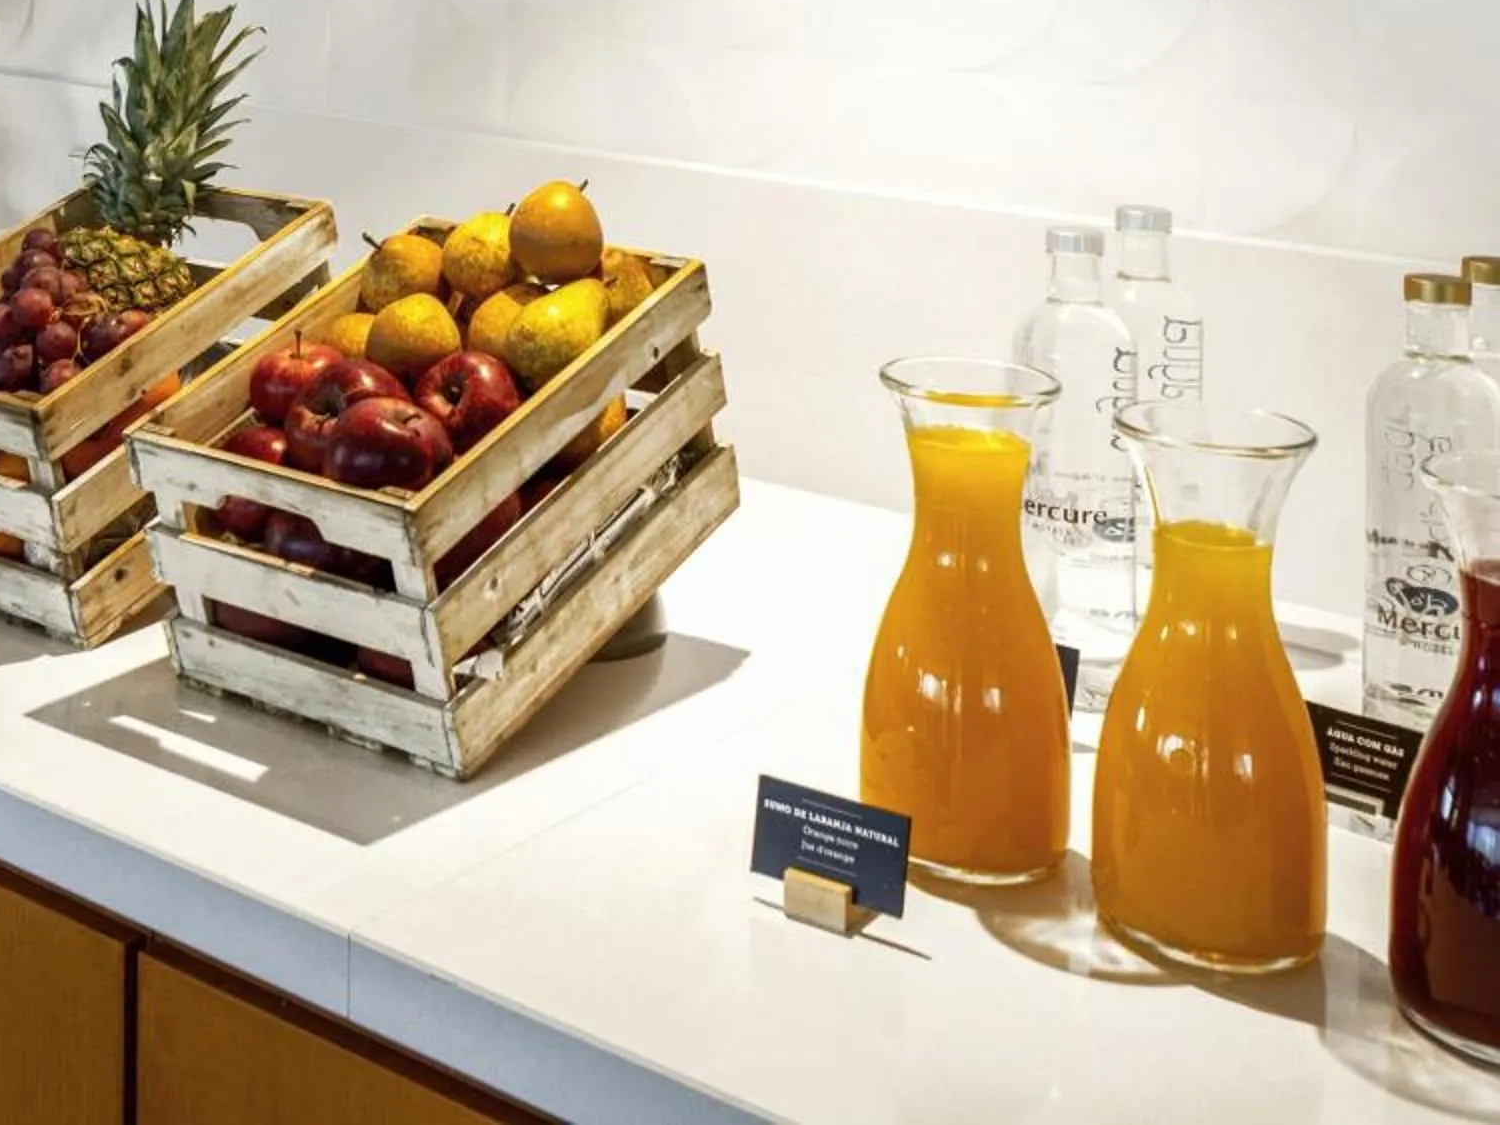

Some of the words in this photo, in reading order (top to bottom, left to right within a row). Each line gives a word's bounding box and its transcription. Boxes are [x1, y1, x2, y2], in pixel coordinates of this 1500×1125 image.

[1024, 498, 1107, 525] ercure
[1377, 604, 1460, 640] Merc
[1356, 736, 1382, 752] COM
[793, 807, 807, 820] DE
[808, 812, 853, 833] LARANJA
[853, 826, 900, 848] NATURAL
